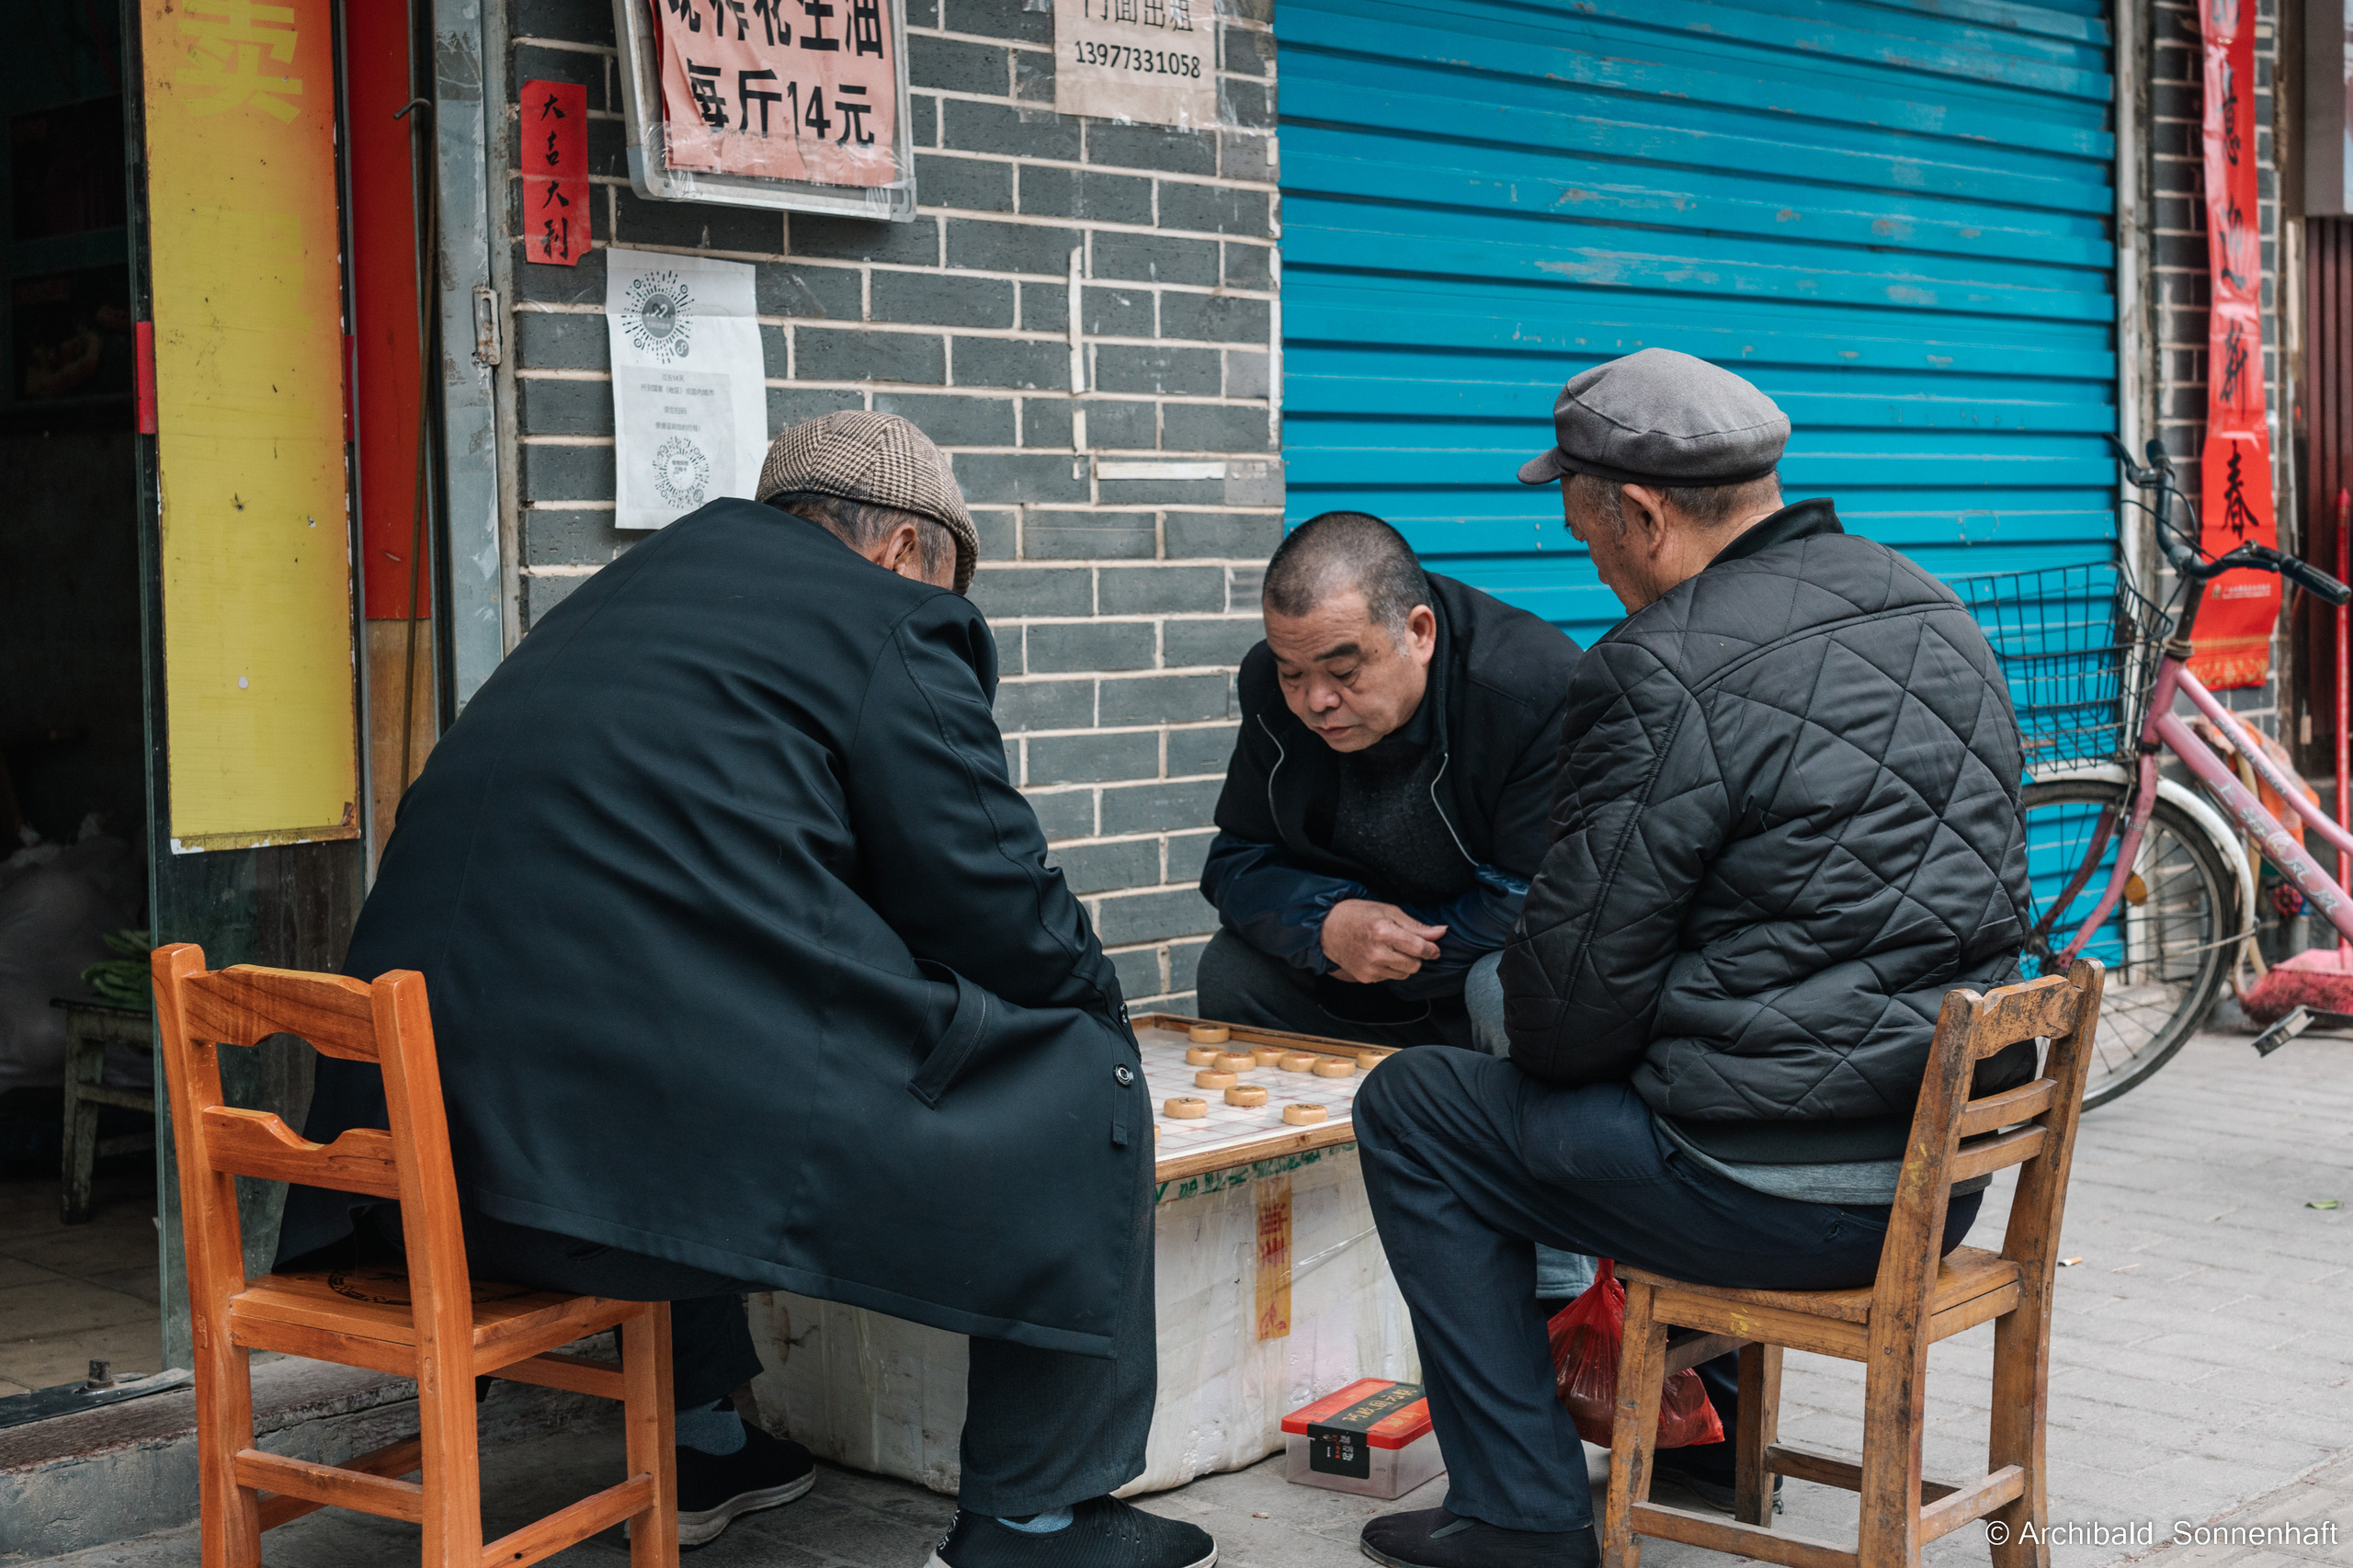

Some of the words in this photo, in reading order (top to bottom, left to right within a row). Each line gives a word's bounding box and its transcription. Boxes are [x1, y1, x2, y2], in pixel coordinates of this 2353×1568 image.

[687, 57, 875, 149] 每斤14元
[1074, 40, 1200, 79] 13977331058
[540, 93, 570, 261] 大吉大利
[2213, 0, 2259, 540] 意迎新春
